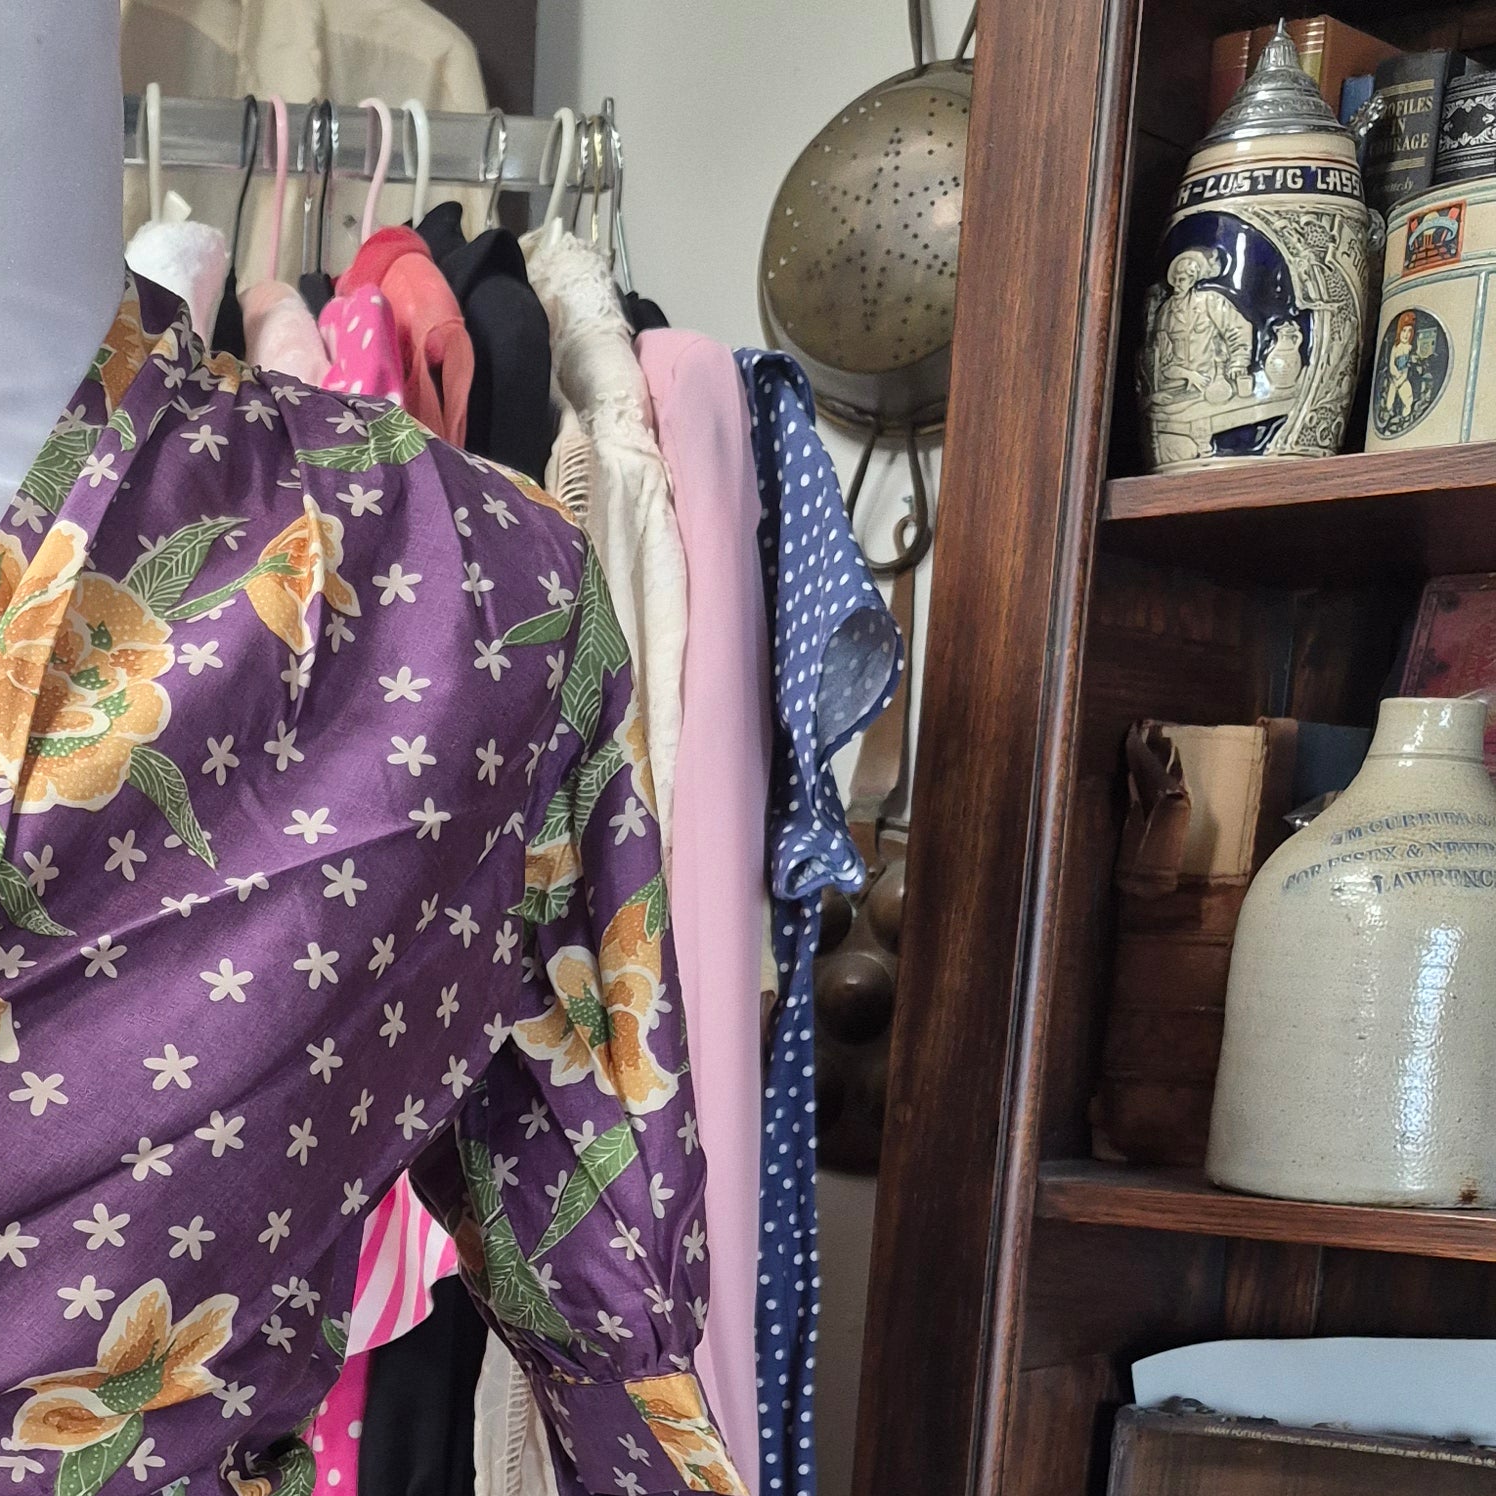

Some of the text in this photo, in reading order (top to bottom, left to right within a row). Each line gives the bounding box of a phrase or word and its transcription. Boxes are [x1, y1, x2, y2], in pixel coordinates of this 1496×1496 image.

[1382, 96, 1434, 119] OFILES
[1391, 117, 1407, 136] IN
[1315, 168, 1365, 205] LASS
[1368, 811, 1472, 834] CURRIER
[1328, 846, 1397, 870] ESSEX
[1406, 843, 1424, 859] &
[1372, 868, 1496, 894] LAWRENC
